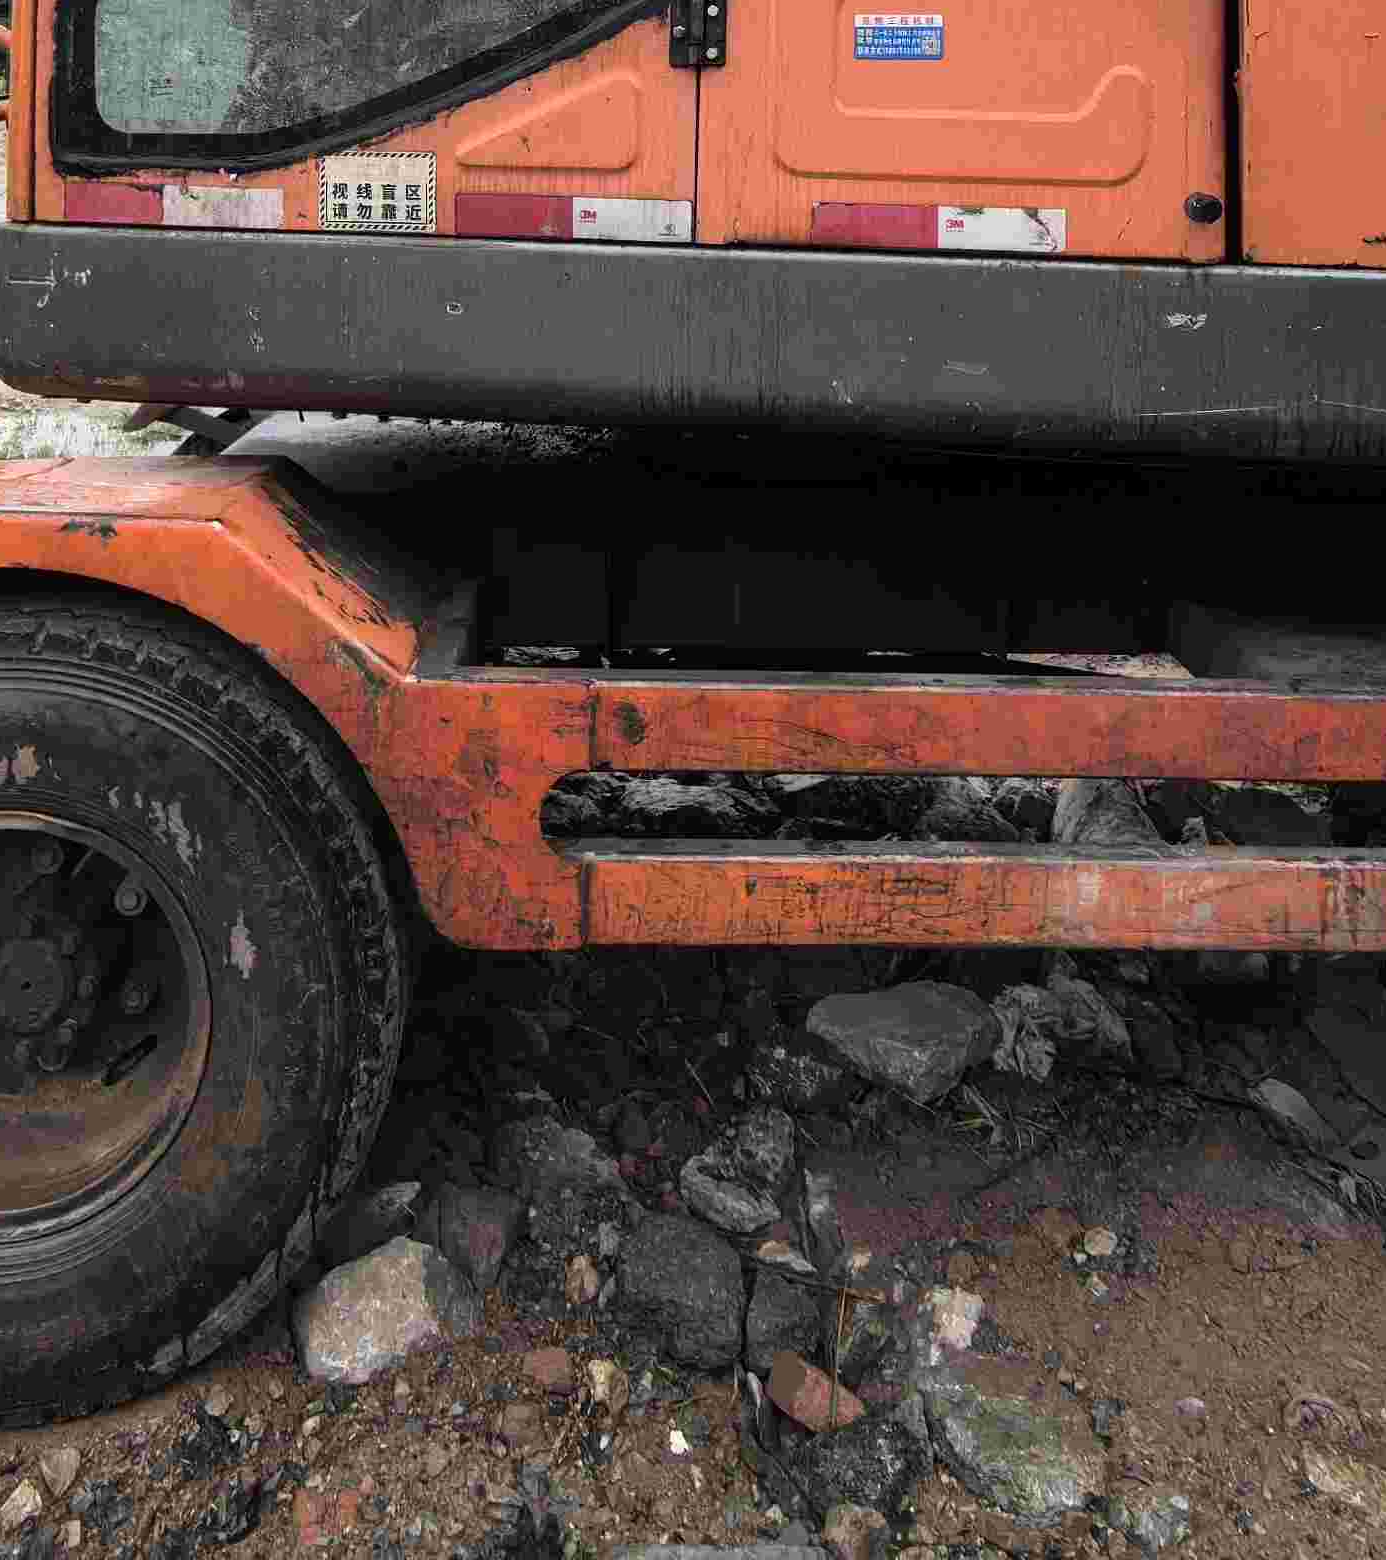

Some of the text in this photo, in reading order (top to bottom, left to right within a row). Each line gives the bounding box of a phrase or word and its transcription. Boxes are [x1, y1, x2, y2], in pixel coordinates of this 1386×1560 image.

[332, 183, 422, 200] 视线盲区
[332, 203, 422, 220] 请勿靠近
